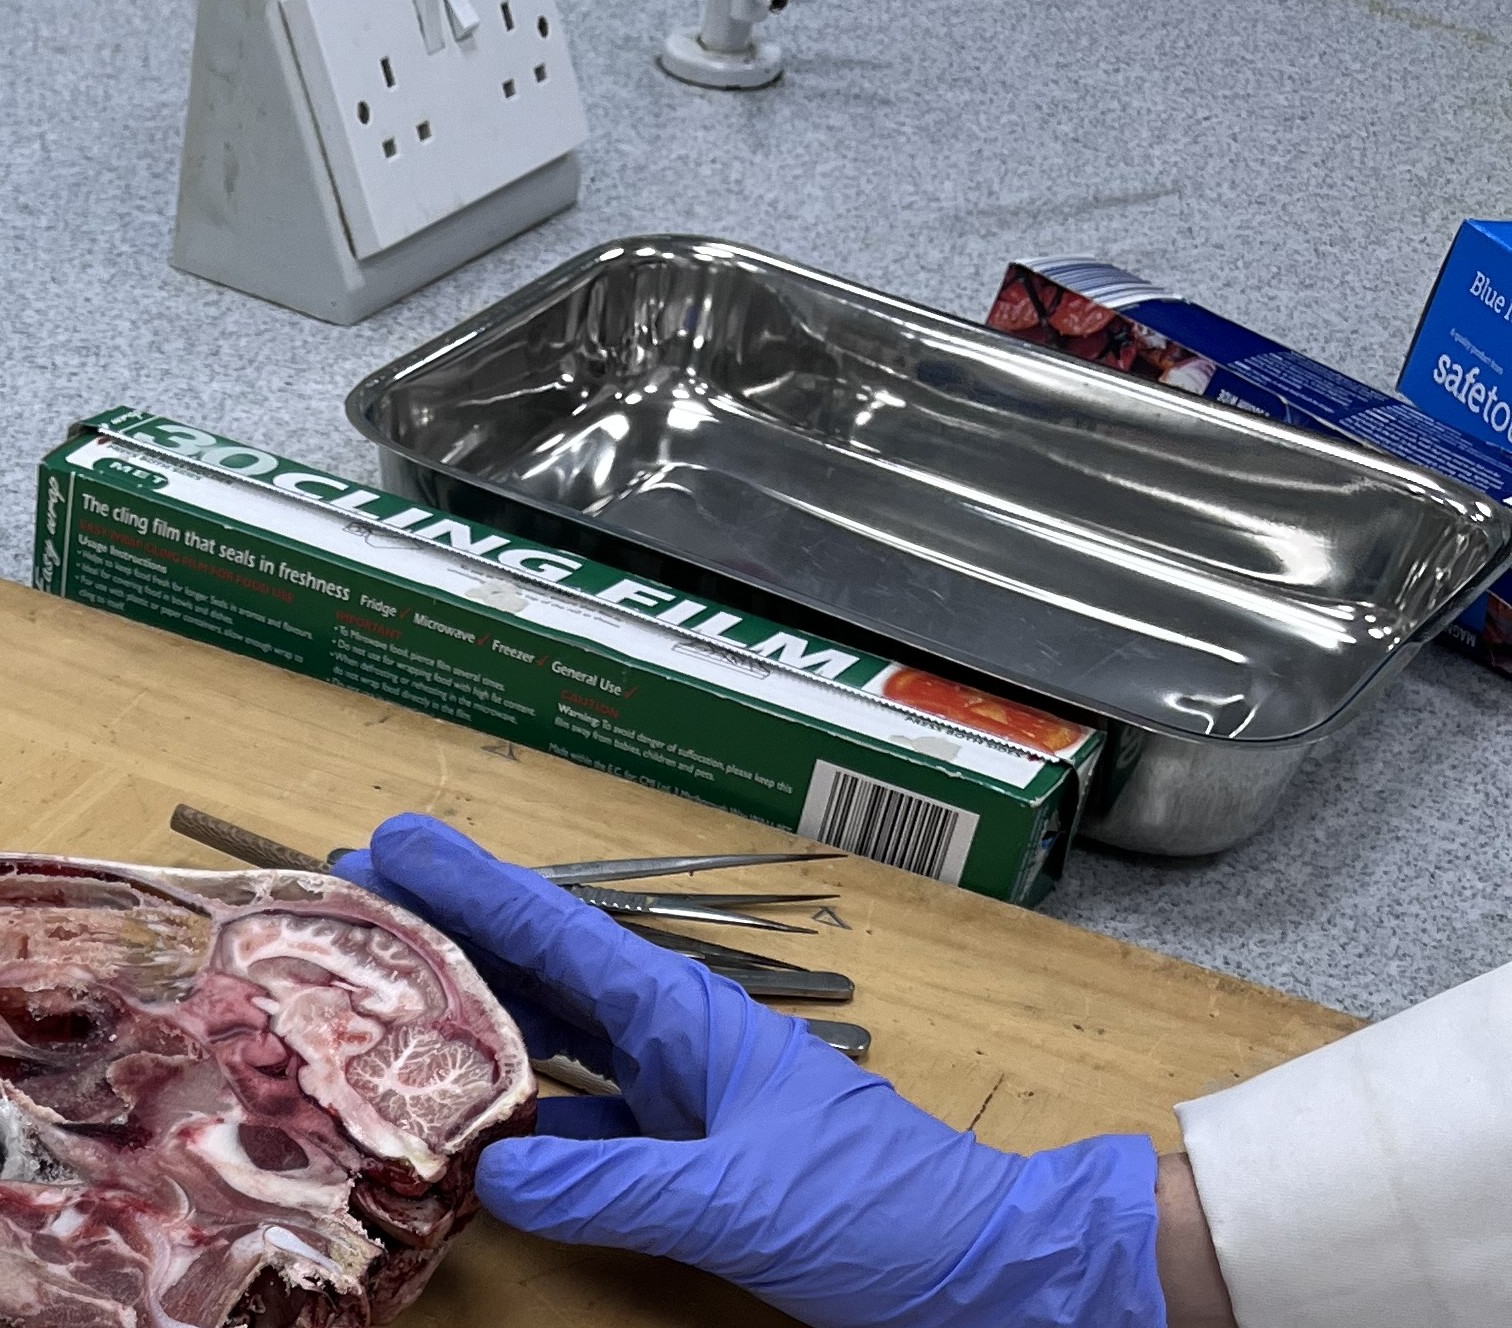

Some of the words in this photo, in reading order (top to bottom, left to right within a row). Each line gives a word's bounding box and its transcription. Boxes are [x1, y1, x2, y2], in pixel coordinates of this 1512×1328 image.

[1470, 271, 1505, 313] Blue
[78, 534, 107, 553] Usage
[109, 545, 167, 574] Instructions
[82, 493, 108, 517] The
[112, 507, 148, 535] cling
[152, 518, 180, 541] film
[184, 531, 215, 554] that
[218, 545, 255, 568] seals
[258, 555, 274, 575] in
[278, 562, 350, 601] freshness
[273, 472, 583, 584] CLING
[595, 579, 860, 681] FILM
[360, 594, 397, 617] Fridge
[413, 612, 475, 643] Microwave
[491, 639, 535, 663] Freezer
[551, 661, 597, 686] General
[599, 678, 622, 696] Use
